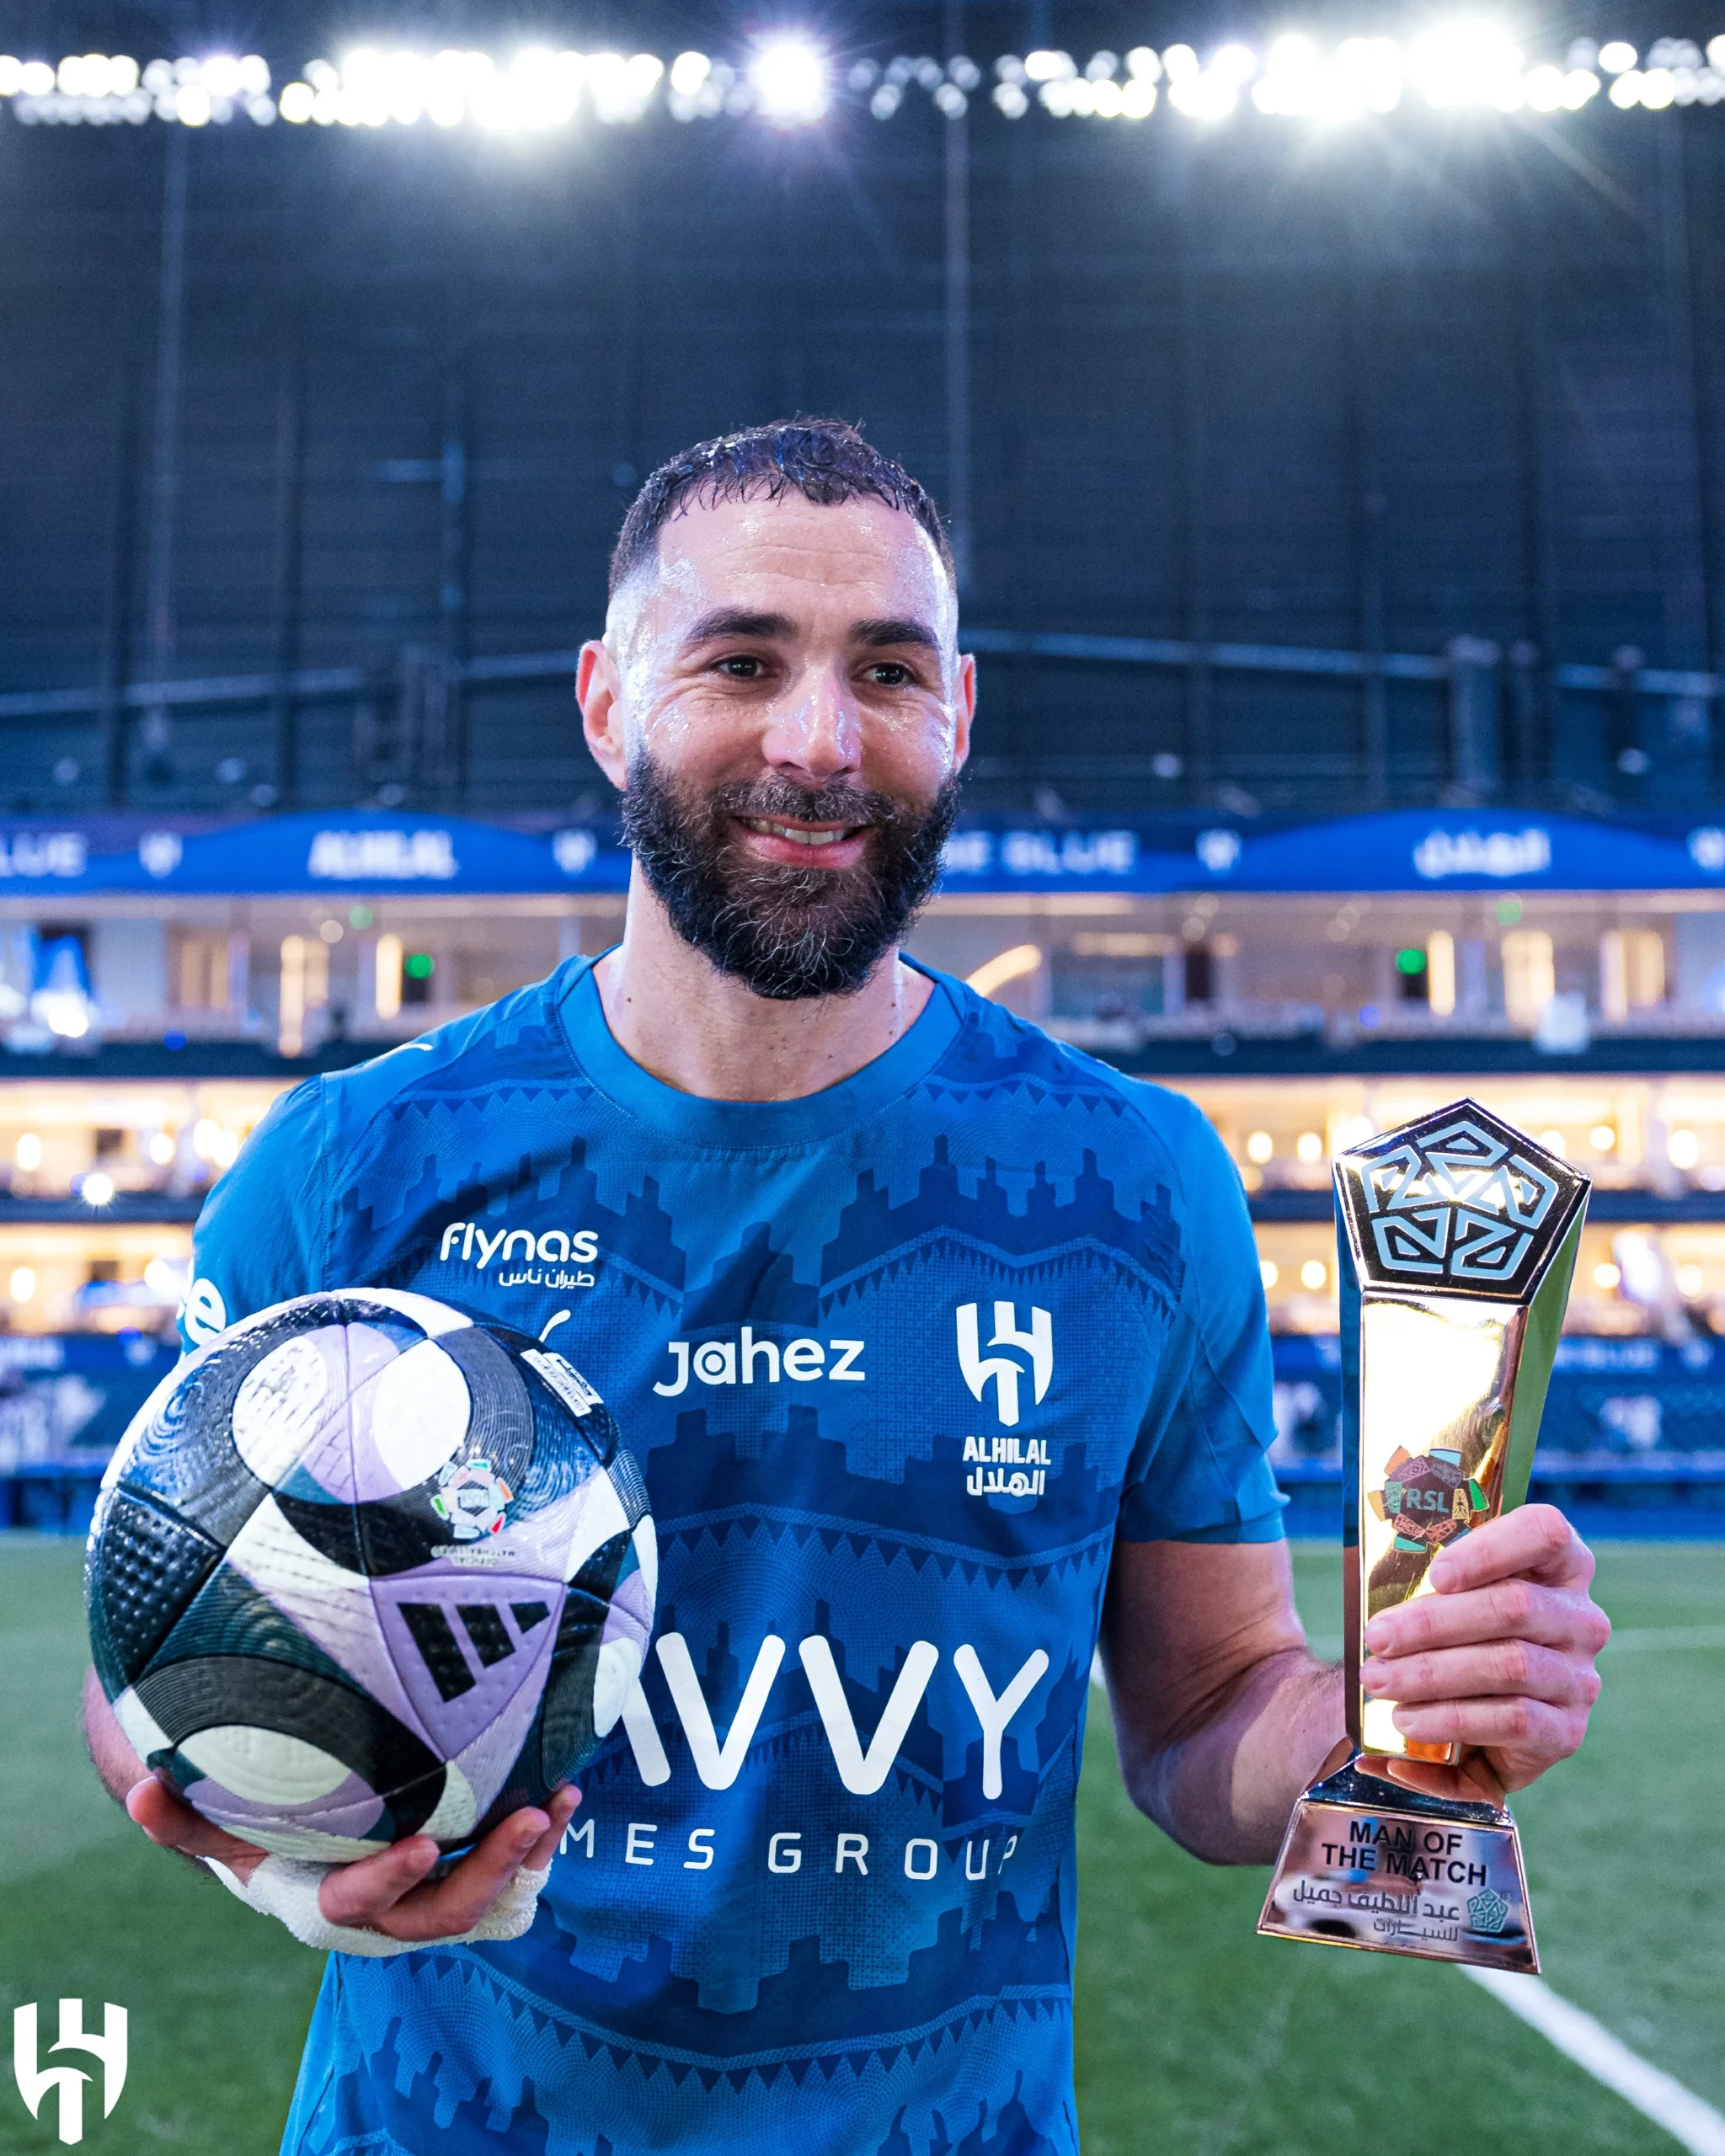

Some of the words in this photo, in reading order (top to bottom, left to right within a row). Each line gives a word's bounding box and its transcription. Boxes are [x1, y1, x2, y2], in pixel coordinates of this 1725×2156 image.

[440, 1222, 599, 1269] flynas
[499, 1268, 542, 1287] ناس
[545, 1268, 595, 1289] طيران
[653, 1326, 865, 1397] jahez
[962, 1436, 1051, 1465] ALHILAL
[966, 1467, 1045, 1497] الهلال
[1407, 1487, 1450, 1513] RSL
[559, 1819, 715, 1870] MES
[767, 1832, 1017, 1881] GROUP
[1349, 1821, 1413, 1852] MAN
[1423, 1831, 1463, 1855] OF
[1322, 1843, 1376, 1871] THE
[1386, 1852, 1487, 1886] MATCH
[1293, 1880, 1343, 1908] جميل
[1348, 1891, 1418, 1917] اللطيف
[1423, 1902, 1460, 1923] عبد
